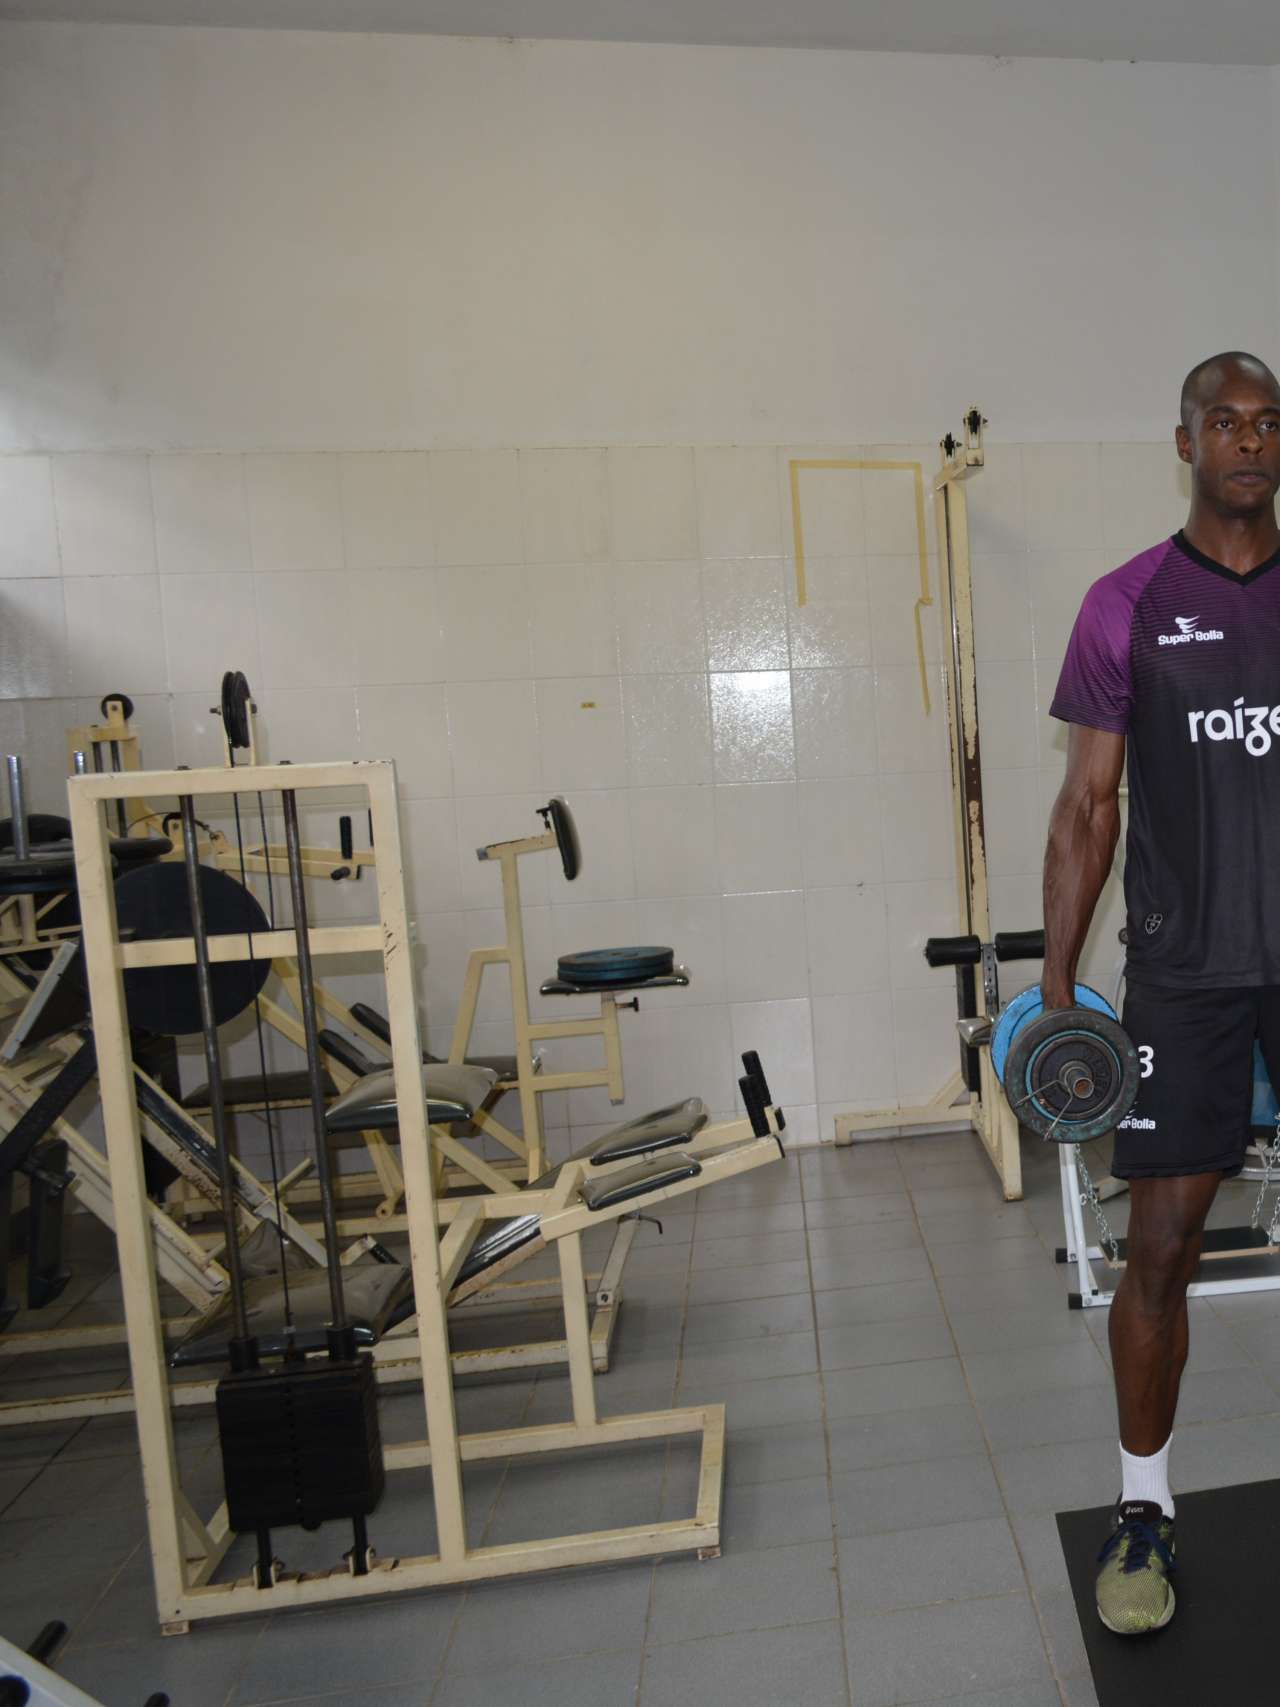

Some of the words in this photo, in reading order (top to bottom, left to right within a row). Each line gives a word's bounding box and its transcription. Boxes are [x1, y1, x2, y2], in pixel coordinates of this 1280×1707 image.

[1158, 633, 1194, 646] Super
[1195, 630, 1224, 641] Bolla
[1138, 1045, 1154, 1078] 3
[1131, 1118, 1156, 1129] Bolla
